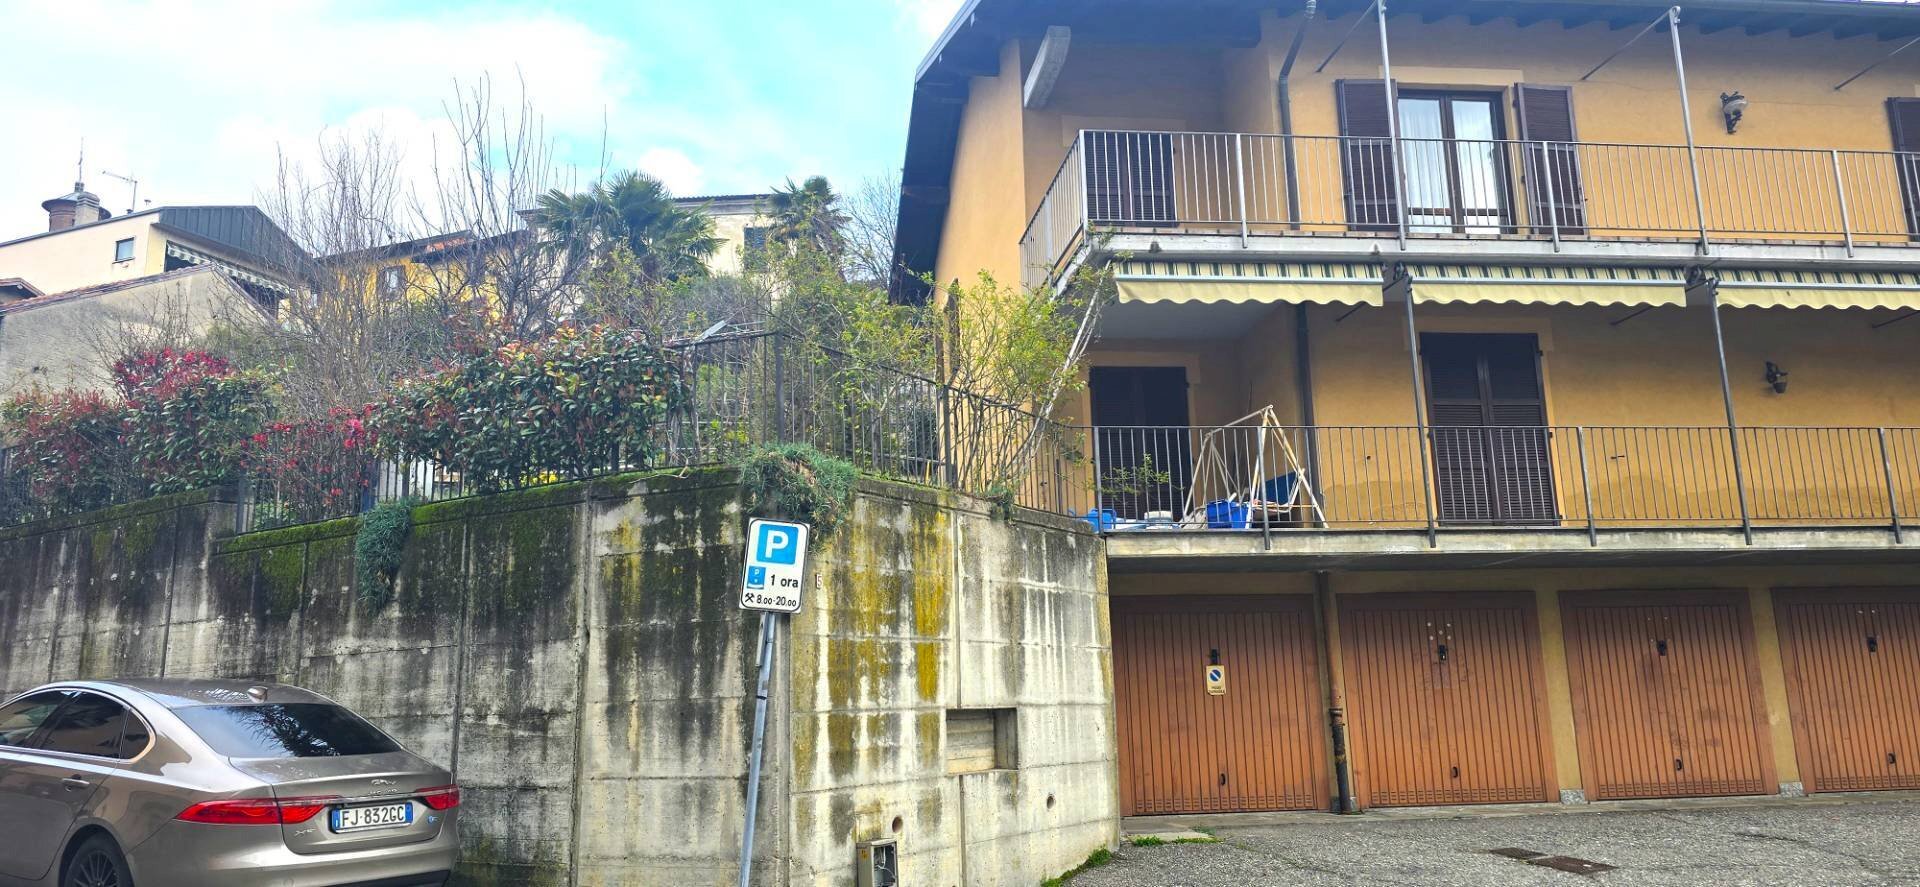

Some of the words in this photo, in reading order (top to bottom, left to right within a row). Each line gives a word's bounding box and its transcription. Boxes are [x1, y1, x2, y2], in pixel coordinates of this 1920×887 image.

[765, 530, 789, 558] P
[770, 574, 776, 586] 1
[780, 578, 799, 588] ora
